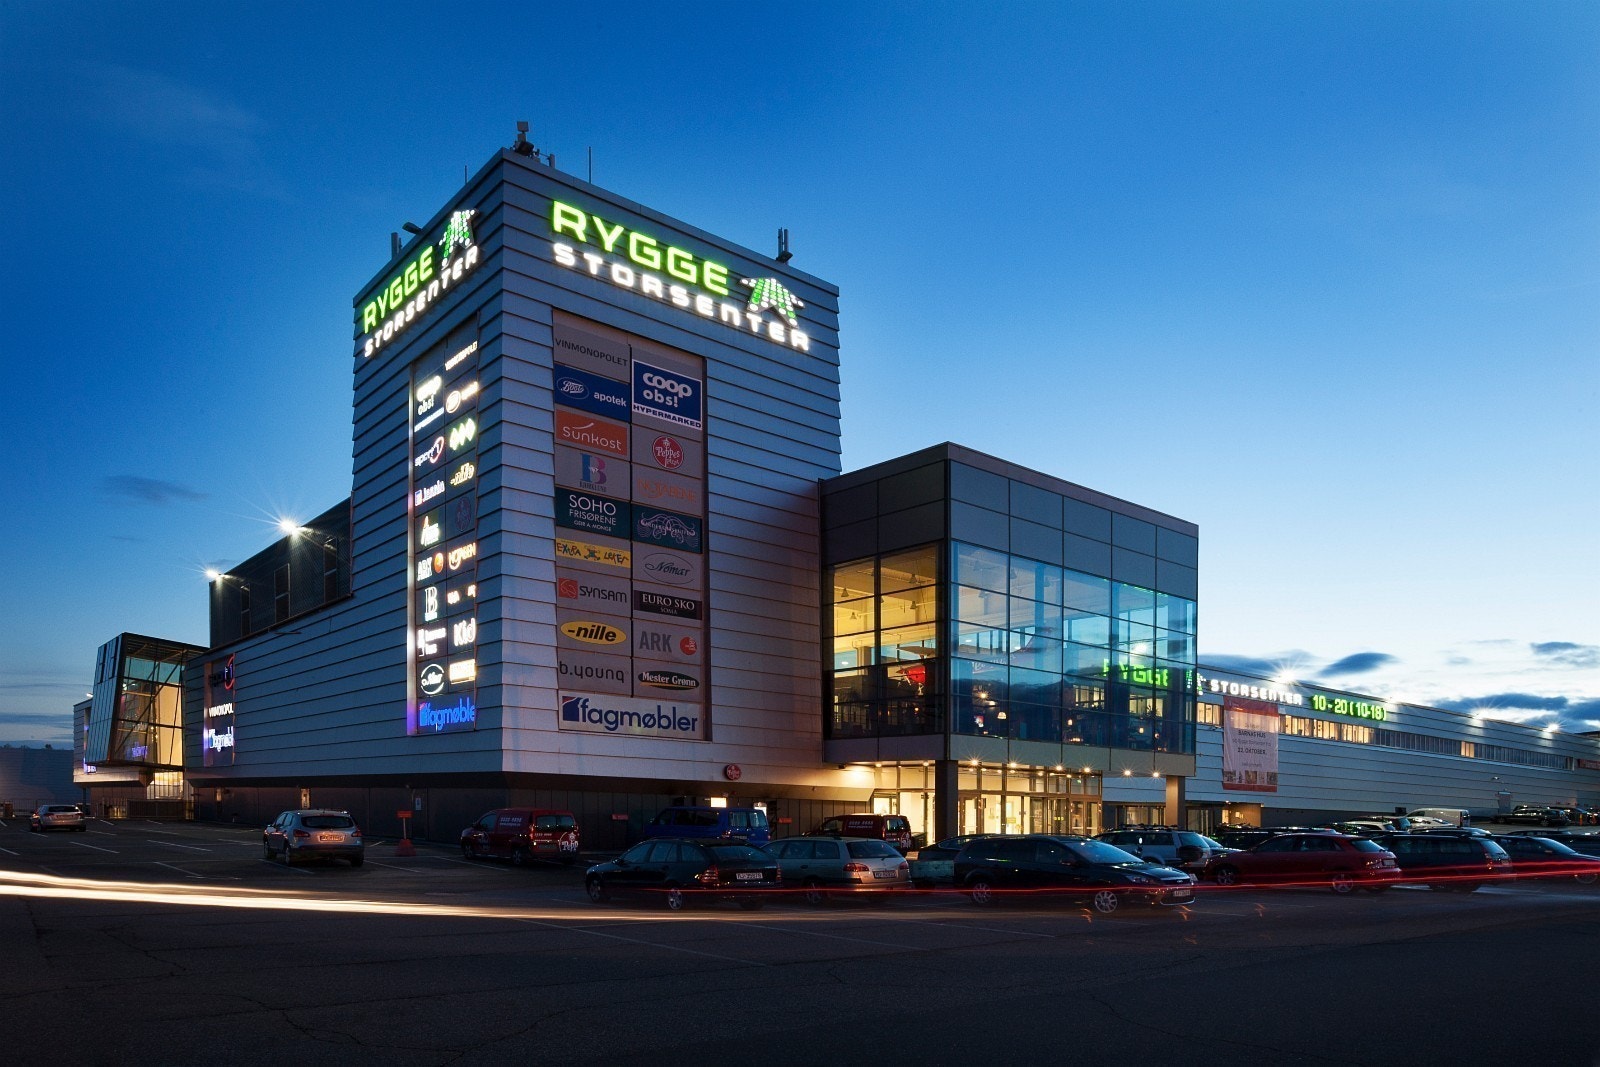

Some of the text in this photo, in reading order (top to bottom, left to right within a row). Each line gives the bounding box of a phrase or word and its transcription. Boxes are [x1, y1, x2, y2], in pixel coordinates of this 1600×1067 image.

[553, 200, 729, 296] RYGGE
[364, 246, 433, 334] RYGGE
[554, 242, 810, 351] STORSENTER
[364, 245, 478, 358] STORSENTER
[555, 338, 628, 366] VINMONOPOLET
[593, 391, 627, 407] apotek
[643, 390, 678, 407] obs!
[633, 404, 701, 429] HYPERMARKED
[655, 446, 681, 458] Peppes
[569, 494, 617, 516] SOHO
[569, 508, 617, 526] FRISØRENE
[579, 585, 627, 603] SYNSAM
[642, 593, 695, 610] EURO SKO
[639, 631, 672, 652] ARK
[559, 661, 624, 683] b.young
[642, 672, 696, 687] Mester Grønn
[1210, 679, 1302, 706] STORSENTER
[580, 699, 698, 731] fagmøbler
